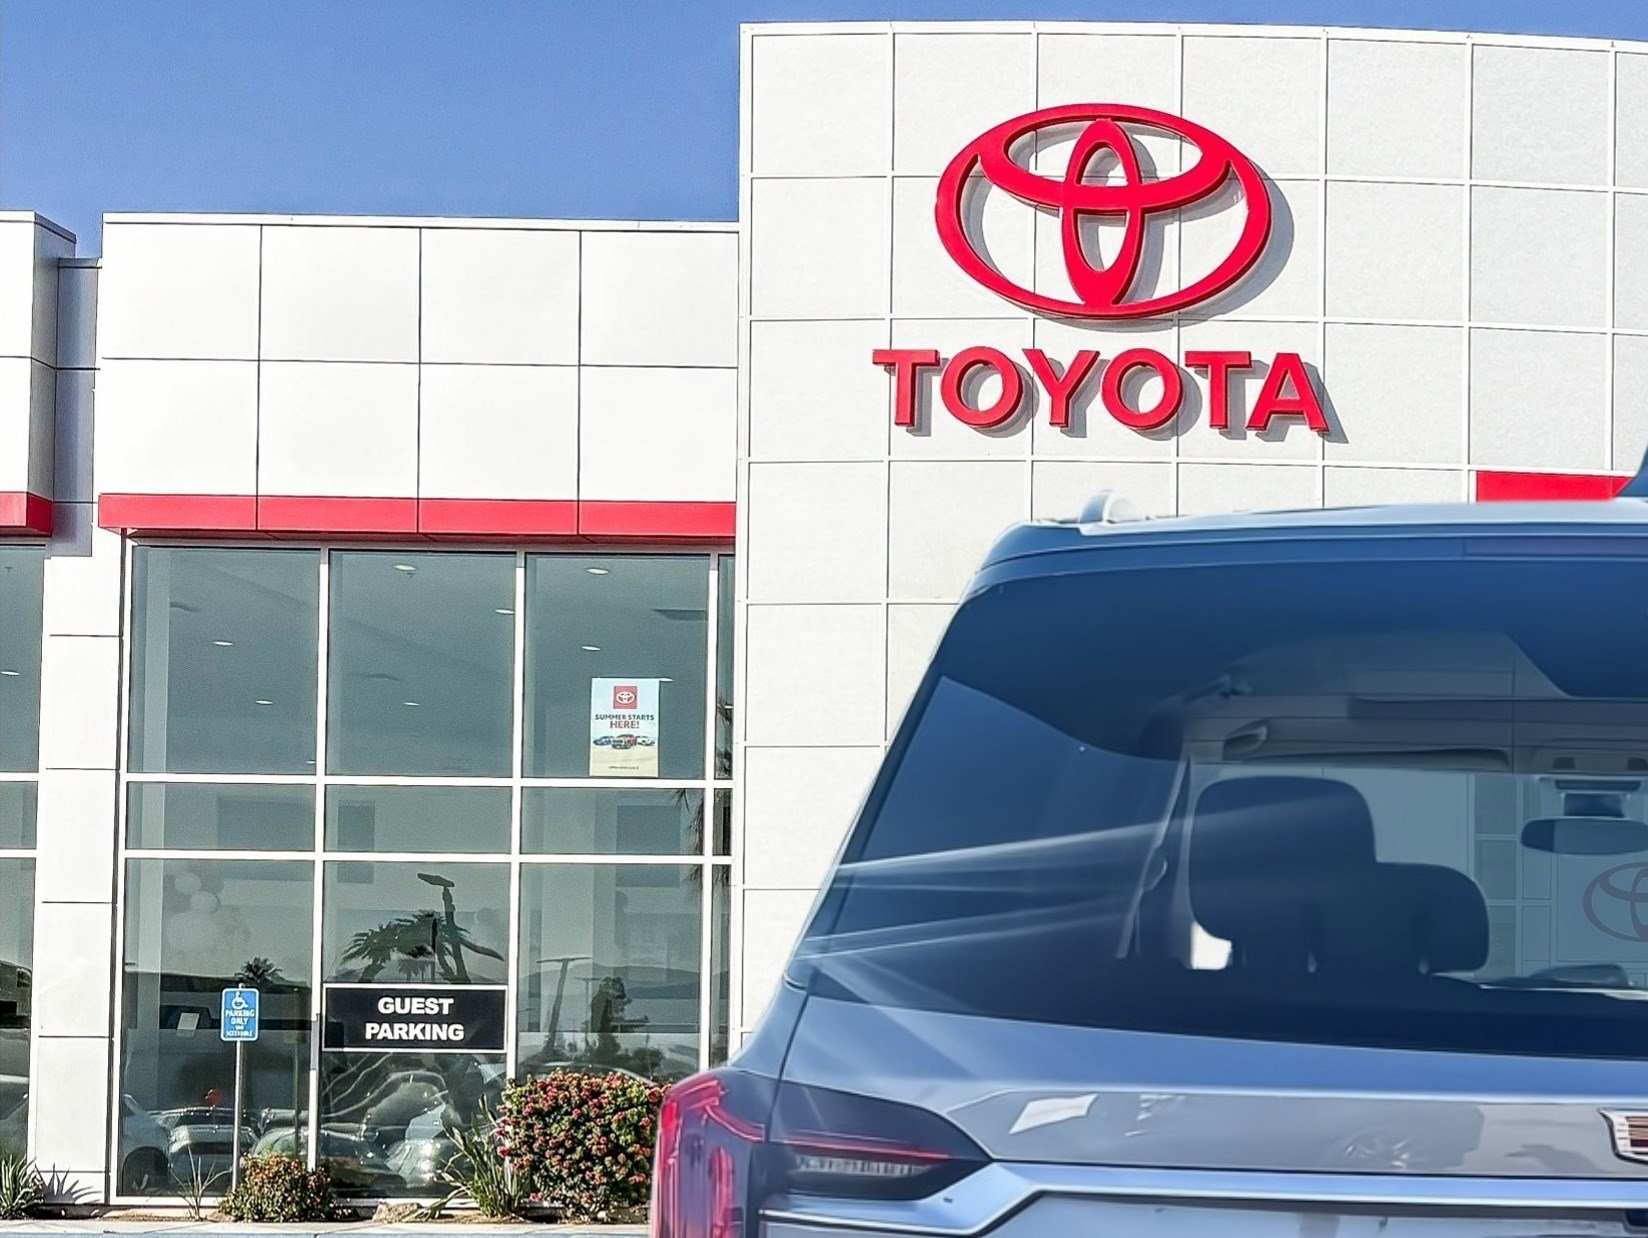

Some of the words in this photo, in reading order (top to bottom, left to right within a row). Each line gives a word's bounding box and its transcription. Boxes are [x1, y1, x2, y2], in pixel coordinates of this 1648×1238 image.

[872, 346, 1330, 433] TOYOTA
[609, 720, 640, 729] HERE!
[377, 997, 454, 1015] GUEST
[225, 1009, 255, 1017] PARKING
[230, 1016, 249, 1025] ONLY
[365, 1022, 465, 1041] PARKING
